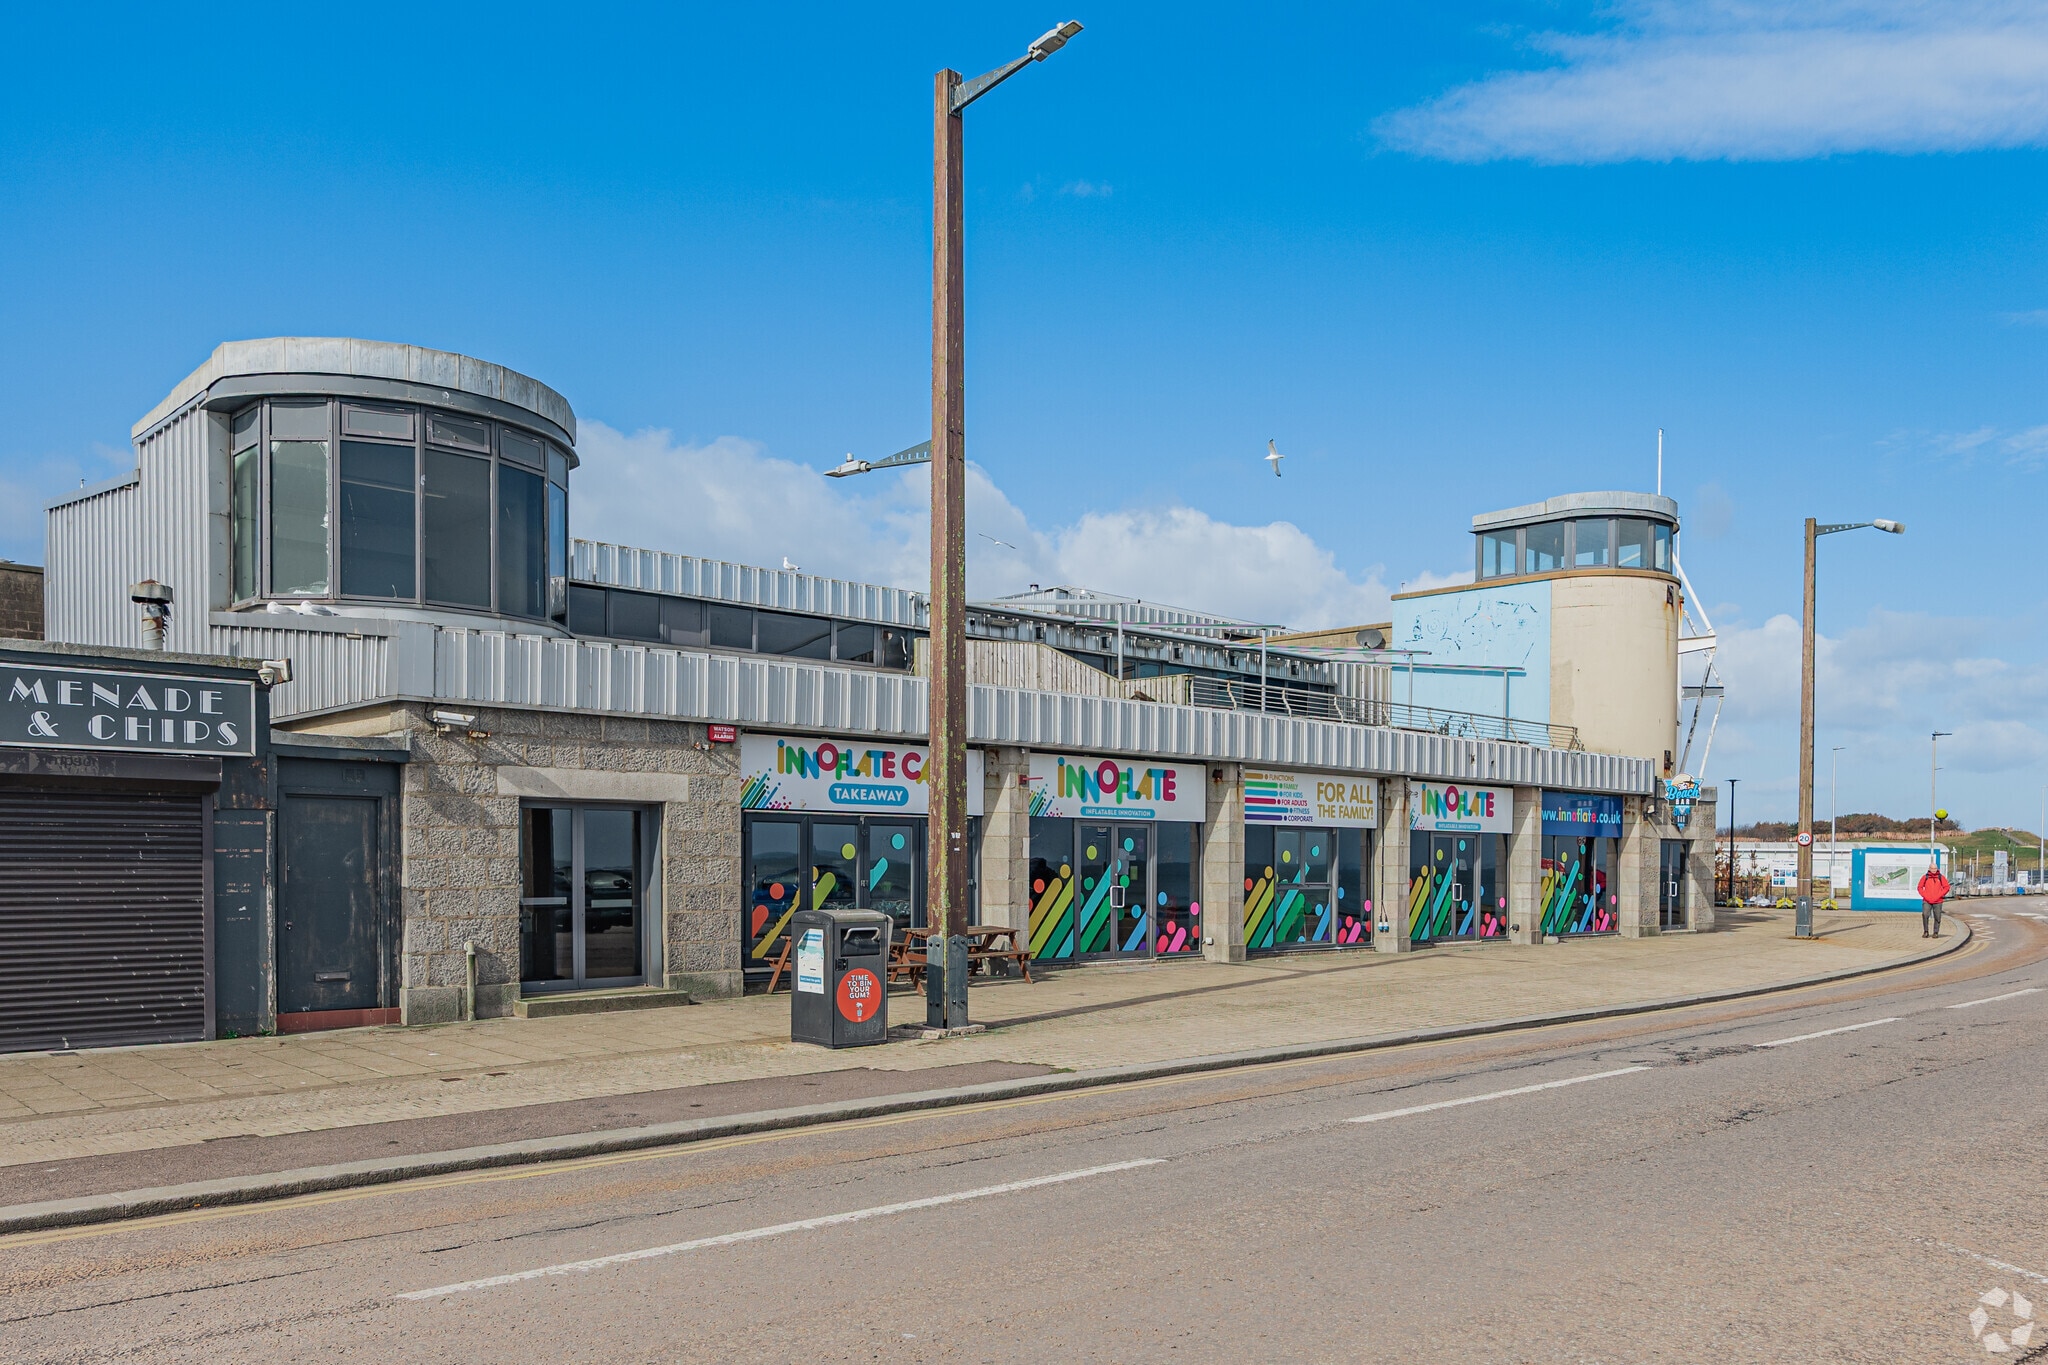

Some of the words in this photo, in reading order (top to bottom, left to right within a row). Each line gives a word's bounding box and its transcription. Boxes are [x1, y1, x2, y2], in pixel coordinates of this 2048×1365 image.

[28, 711, 59, 737] &
[88, 714, 238, 746] CHIPS
[834, 788, 903, 802] TAKEAWAY
[1317, 782, 1345, 803] FOR
[1349, 784, 1373, 804] ALL
[1666, 782, 1700, 800] Beach
[1085, 808, 1117, 816] INFLATABLE
[1118, 809, 1151, 817] INNOVATION
[1287, 815, 1313, 823] CORPORATE
[1317, 804, 1335, 818] THE
[1339, 805, 1374, 820] FAMILY!
[1541, 806, 1621, 824] ww.innoflate.co.uk
